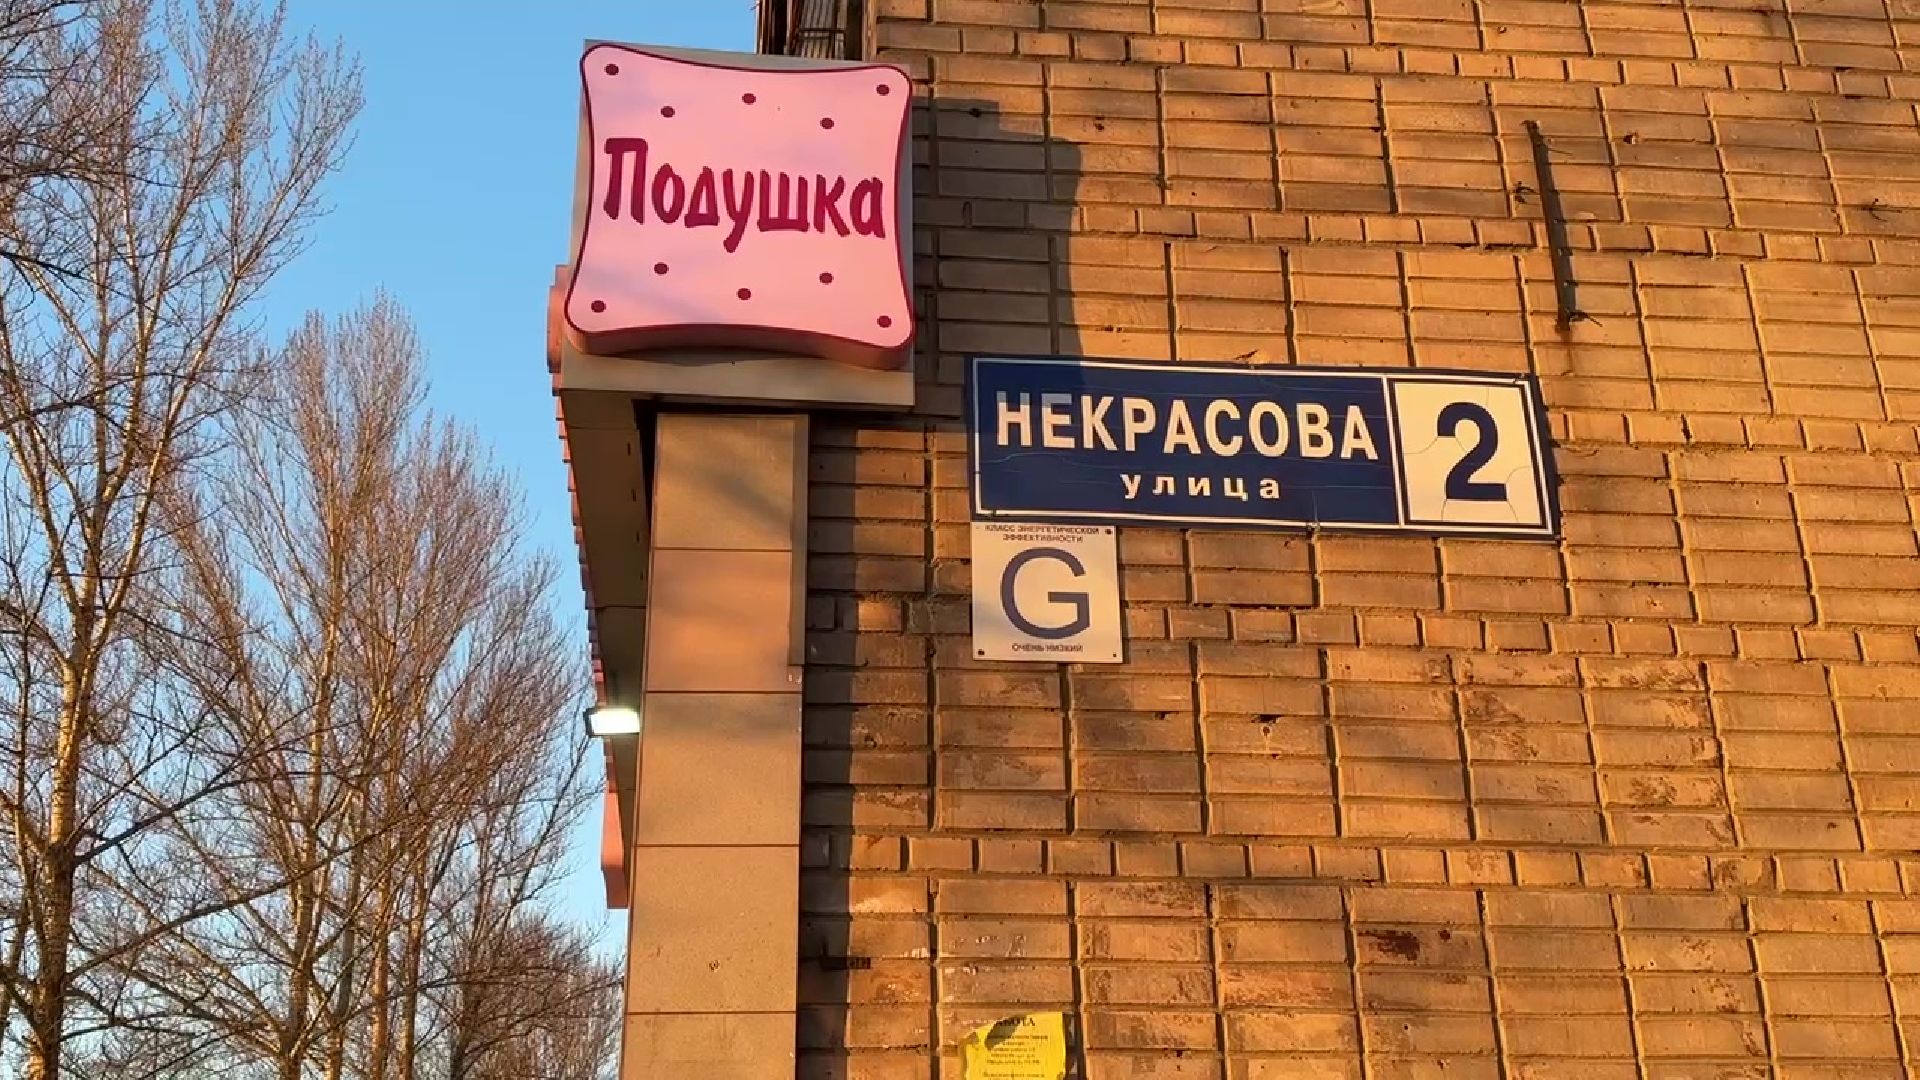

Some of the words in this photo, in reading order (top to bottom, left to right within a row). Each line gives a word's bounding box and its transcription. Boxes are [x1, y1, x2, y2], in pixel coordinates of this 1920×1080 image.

[603, 137, 886, 253] Подушка
[996, 390, 1379, 461] НЕКРАСОВА
[1436, 401, 1507, 501] 2
[1121, 471, 1281, 501] улица
[985, 524, 1015, 533] КЛАСС
[1017, 525, 1099, 535] ЭНЕРГЕТИЧЕСКОЙ
[1002, 534, 1083, 543] ЭФФЕКТИВНОСТИ
[1000, 547, 1090, 640] G
[1012, 642, 1045, 652] ОЧЕНЬ
[1047, 642, 1083, 653] НИЗКИЙ
